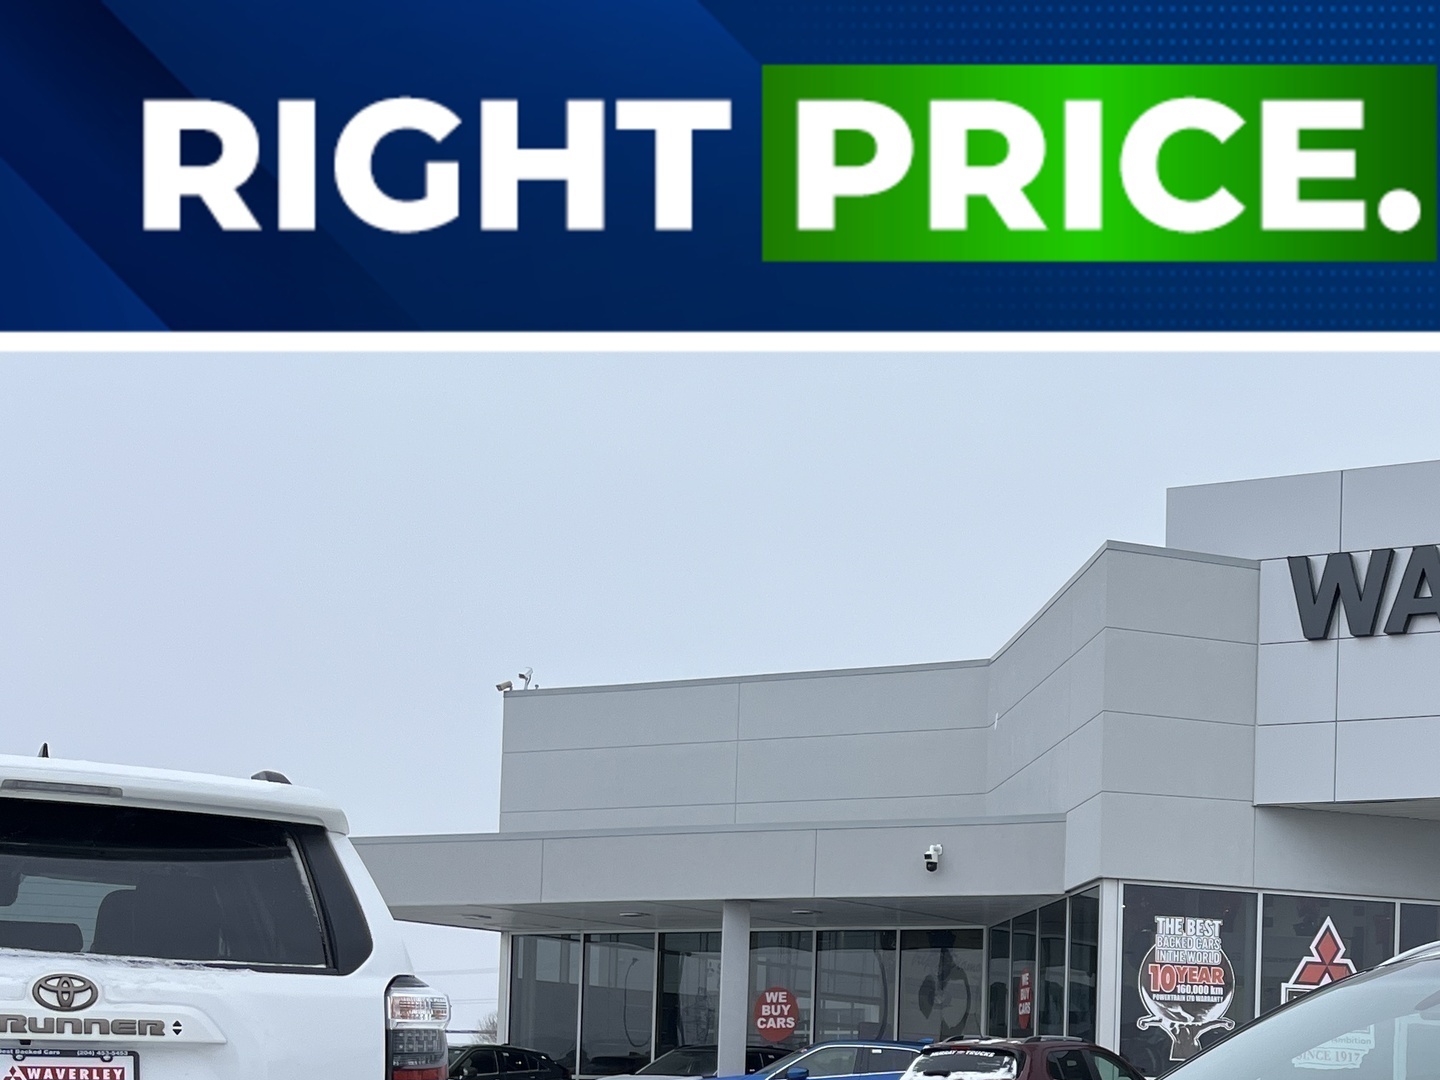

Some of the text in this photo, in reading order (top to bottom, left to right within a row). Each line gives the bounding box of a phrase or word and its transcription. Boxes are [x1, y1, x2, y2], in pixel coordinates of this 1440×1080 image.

[1156, 917, 1223, 938] THE BEST
[1156, 935, 1221, 950] BACKED CARS
[1156, 949, 1221, 964] IN THE WORLD
[1149, 964, 1225, 992] 10 YEAR
[765, 991, 788, 1003] WE
[761, 1004, 791, 1016] BUY
[756, 1017, 796, 1029] CARS
[1335, 1050, 1362, 1063] 1917
[26, 1067, 123, 1080] WAVERLEY
